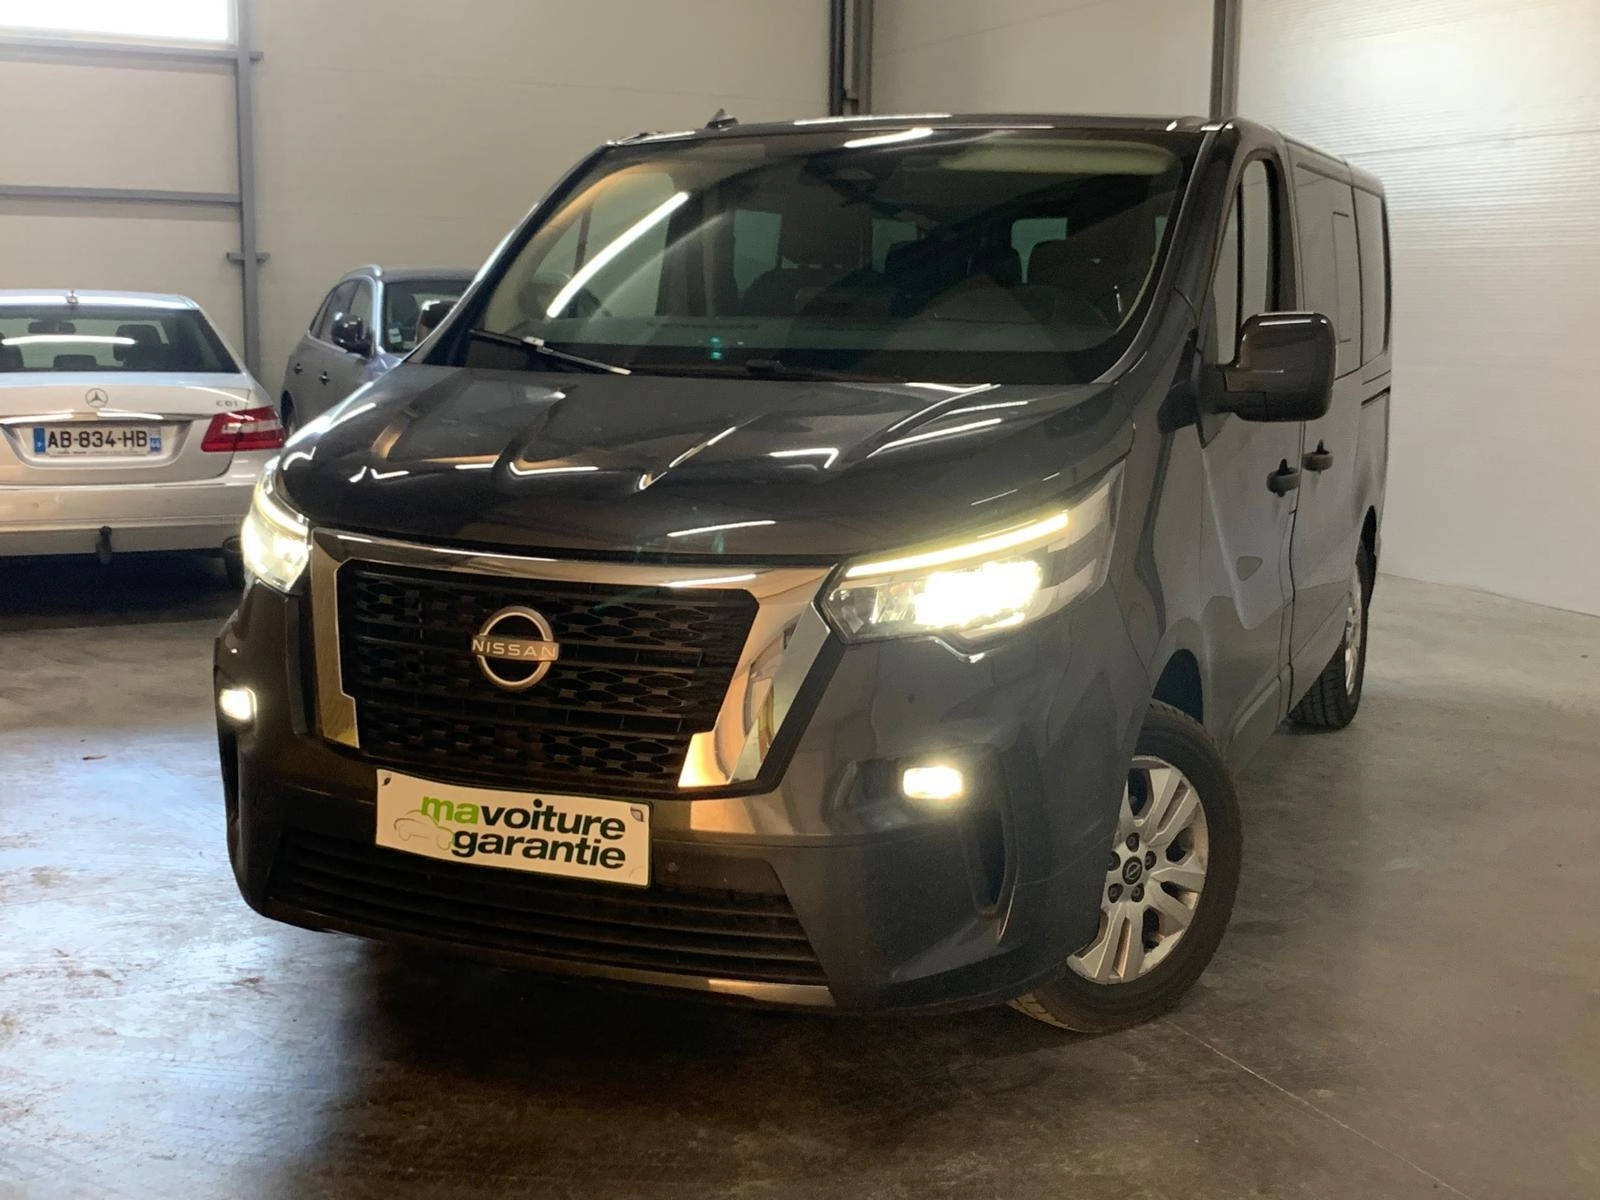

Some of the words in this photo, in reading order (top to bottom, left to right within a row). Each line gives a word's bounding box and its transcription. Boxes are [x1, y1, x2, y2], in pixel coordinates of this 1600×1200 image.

[47, 430, 148, 449] AB-834-HB
[472, 639, 556, 658] NISSAN
[421, 796, 627, 841] mavoiture
[451, 829, 627, 870] garantie
